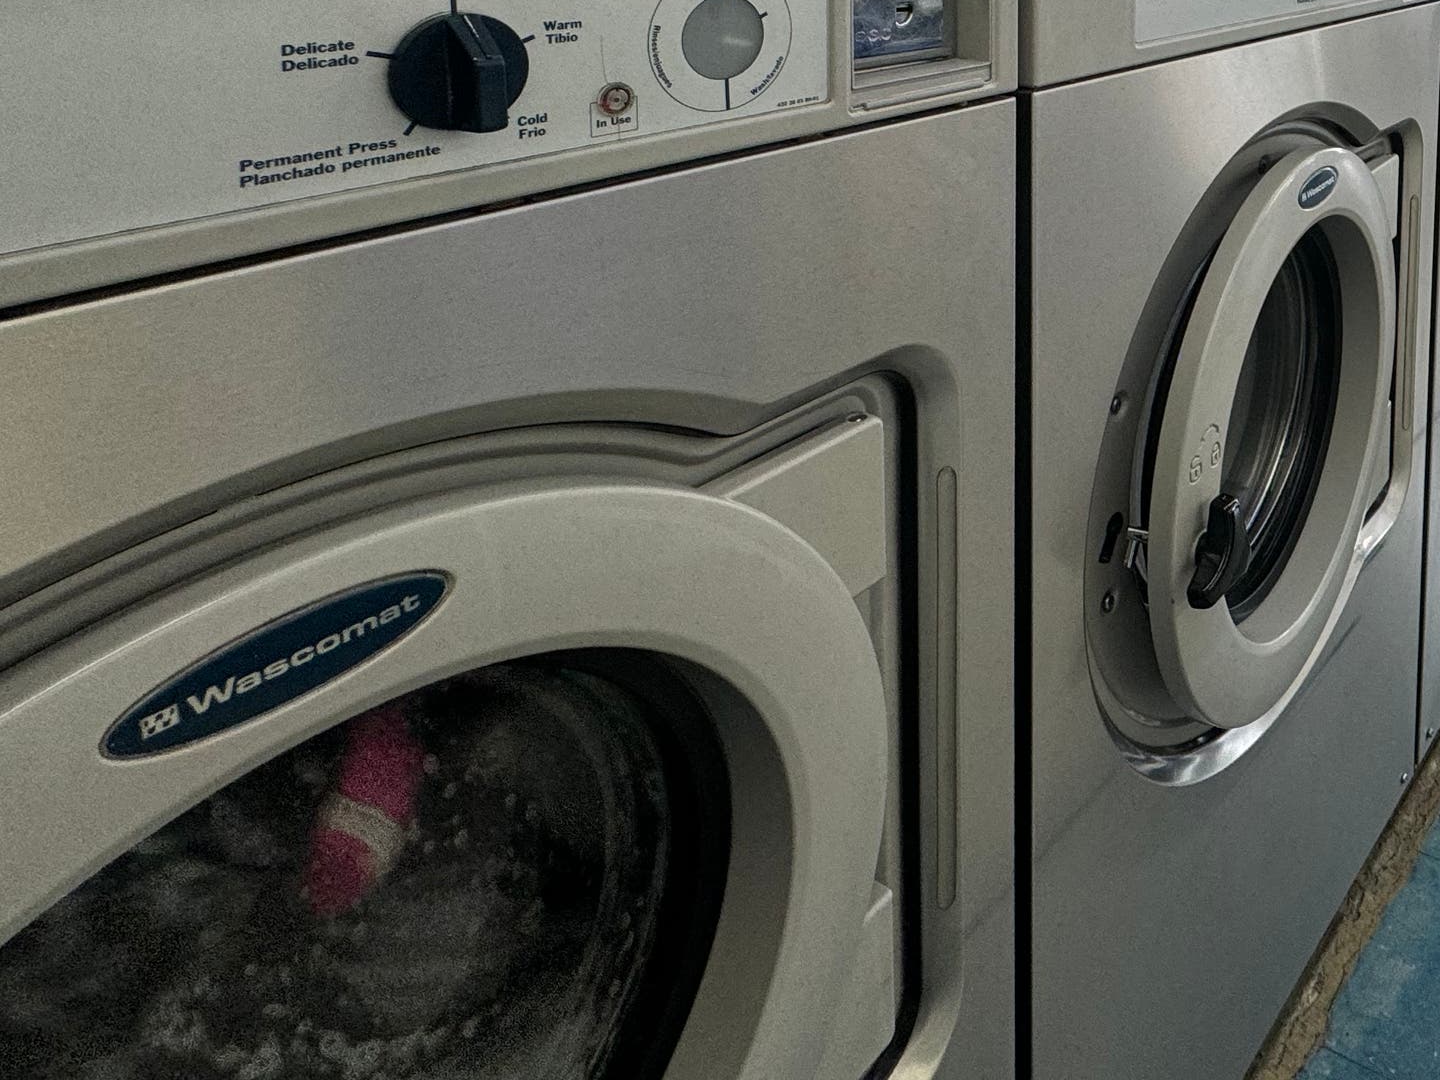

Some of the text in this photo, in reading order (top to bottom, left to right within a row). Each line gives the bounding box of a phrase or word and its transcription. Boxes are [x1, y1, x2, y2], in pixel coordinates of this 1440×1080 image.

[543, 18, 583, 31] Warm
[546, 32, 578, 44] Tibio
[281, 40, 355, 56] Delicate
[281, 54, 360, 72] Delicado
[517, 113, 548, 126] Cold
[596, 115, 632, 128] In Use
[518, 126, 546, 140] Frio
[239, 137, 397, 173] Permanent Press
[239, 144, 442, 188] Planchado permanente
[187, 592, 421, 715] Wascomat
